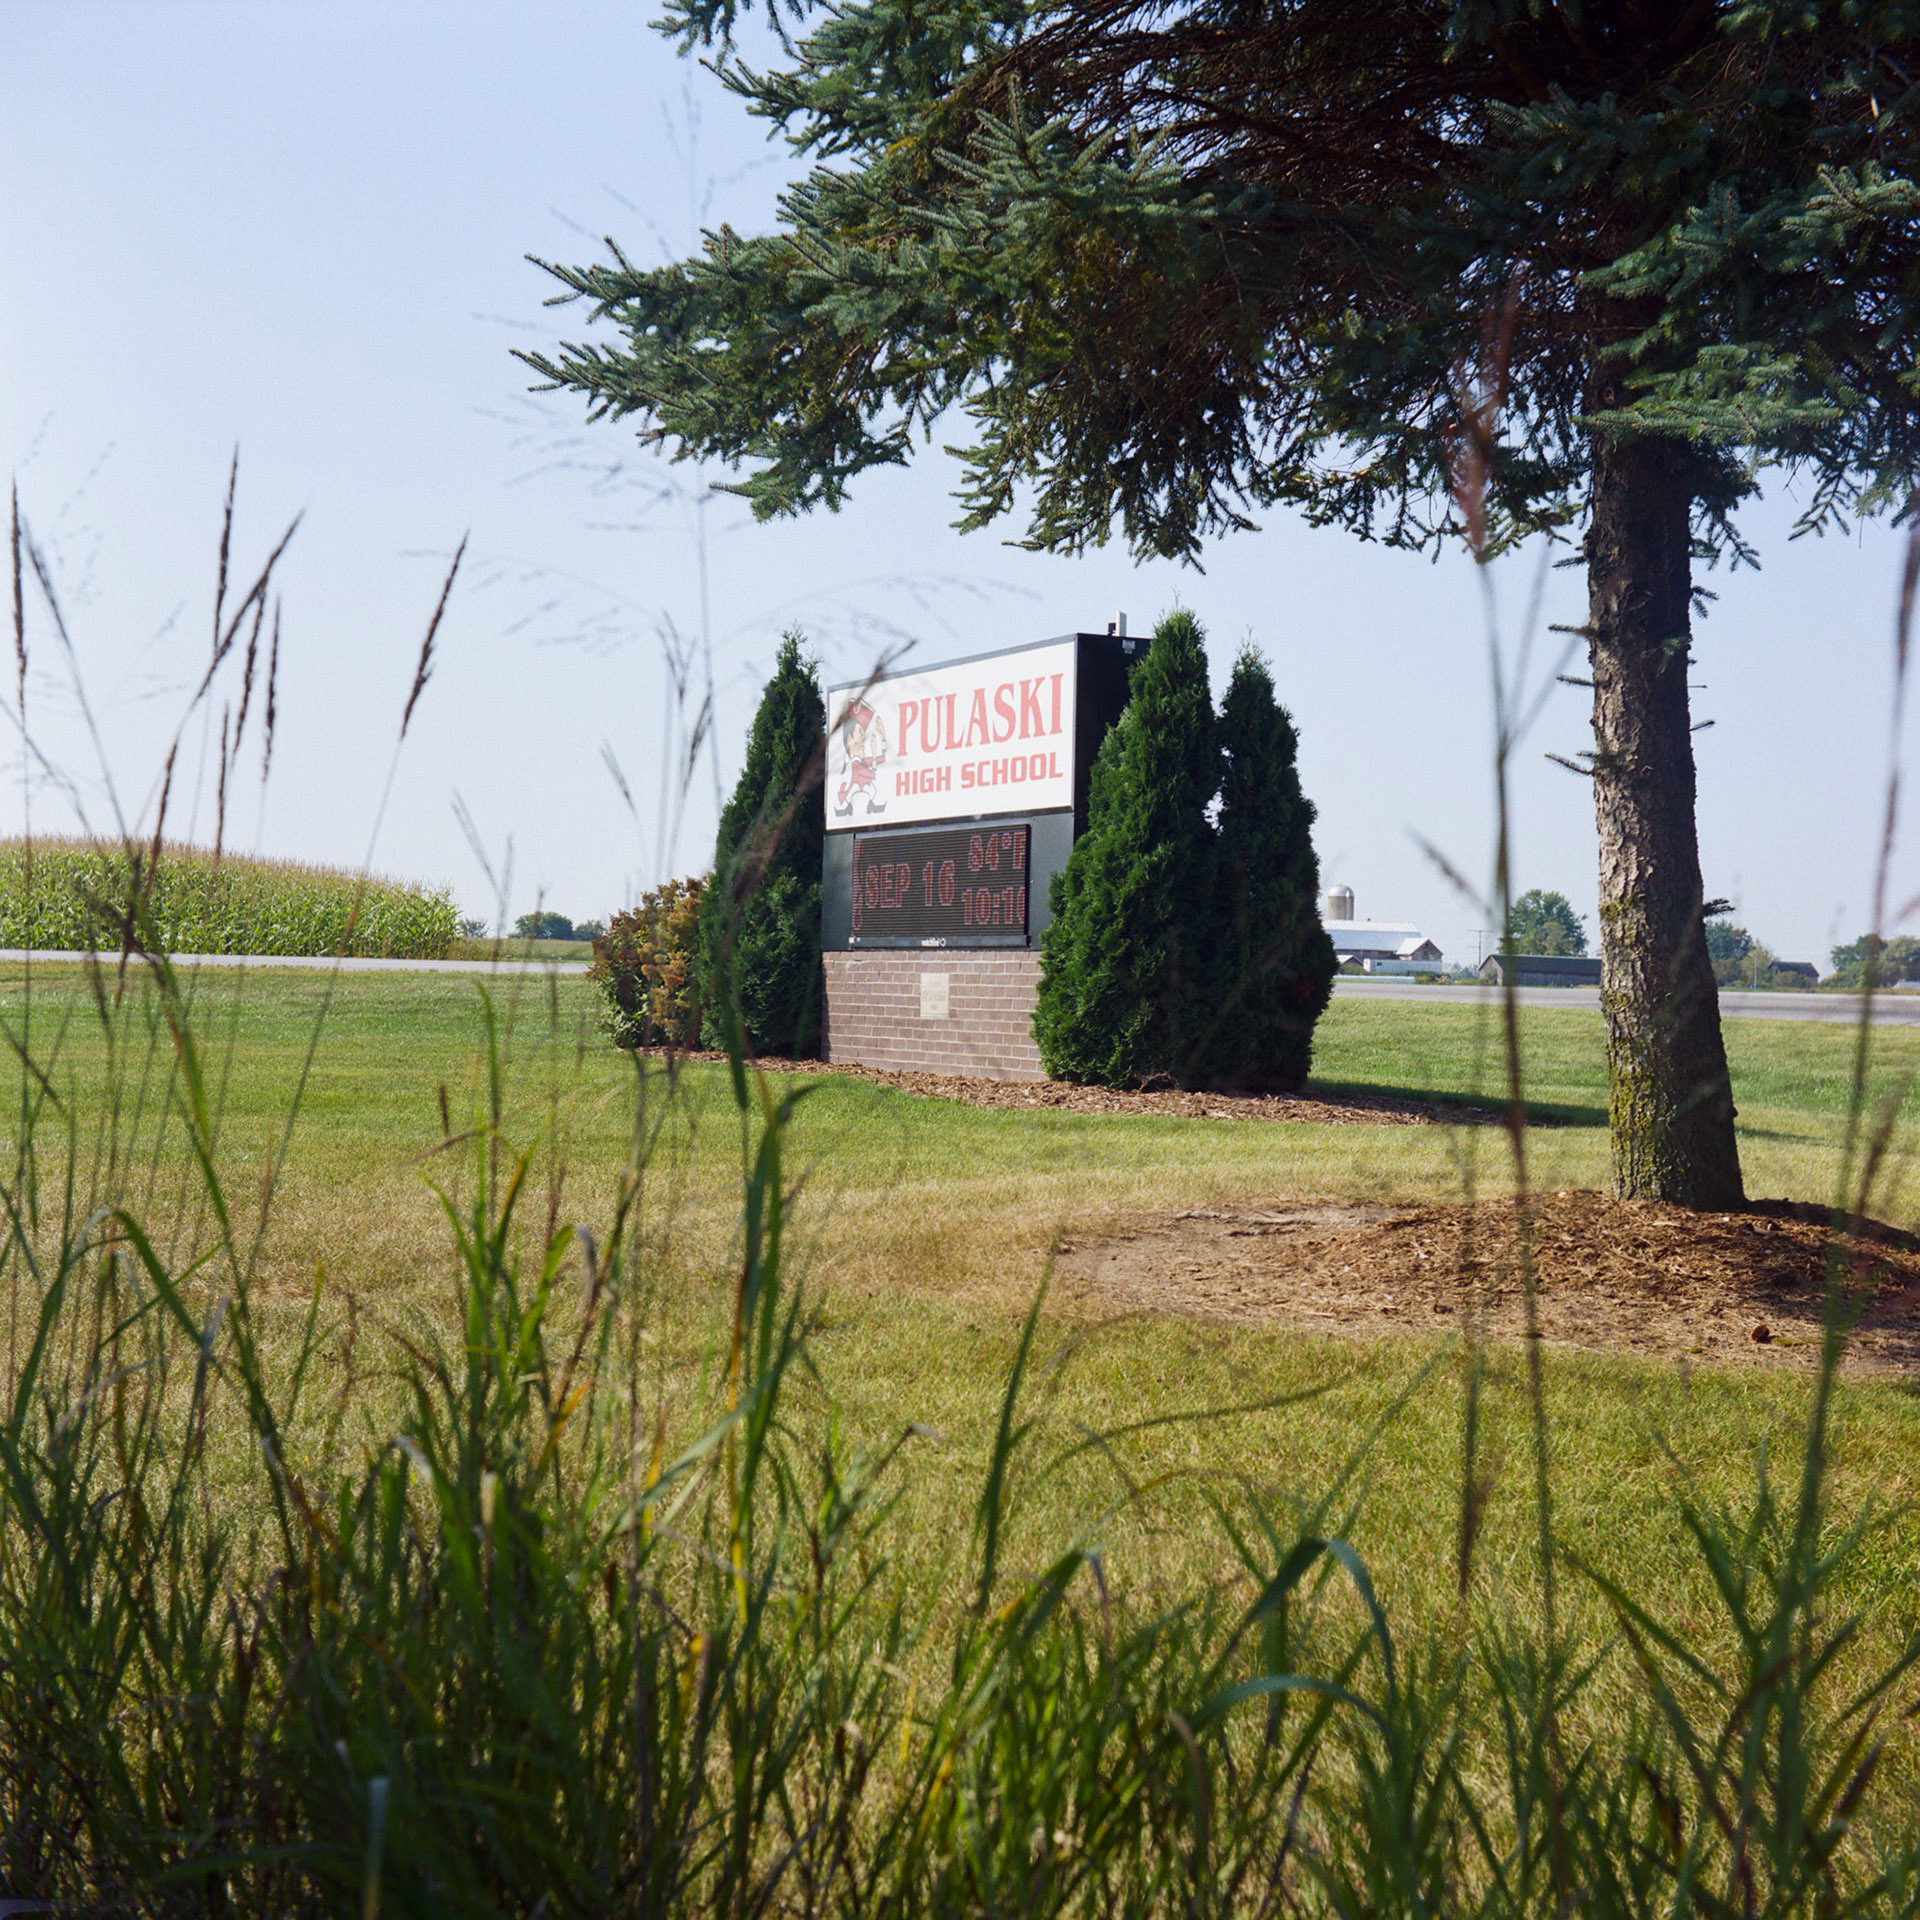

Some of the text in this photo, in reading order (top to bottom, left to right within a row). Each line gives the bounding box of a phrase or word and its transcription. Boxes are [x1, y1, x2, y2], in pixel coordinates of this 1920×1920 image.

[897, 673, 1064, 757] PULASKI
[895, 752, 1063, 797] HIGH SCHOOL
[865, 863, 911, 909] SEP
[922, 860, 956, 907] 16
